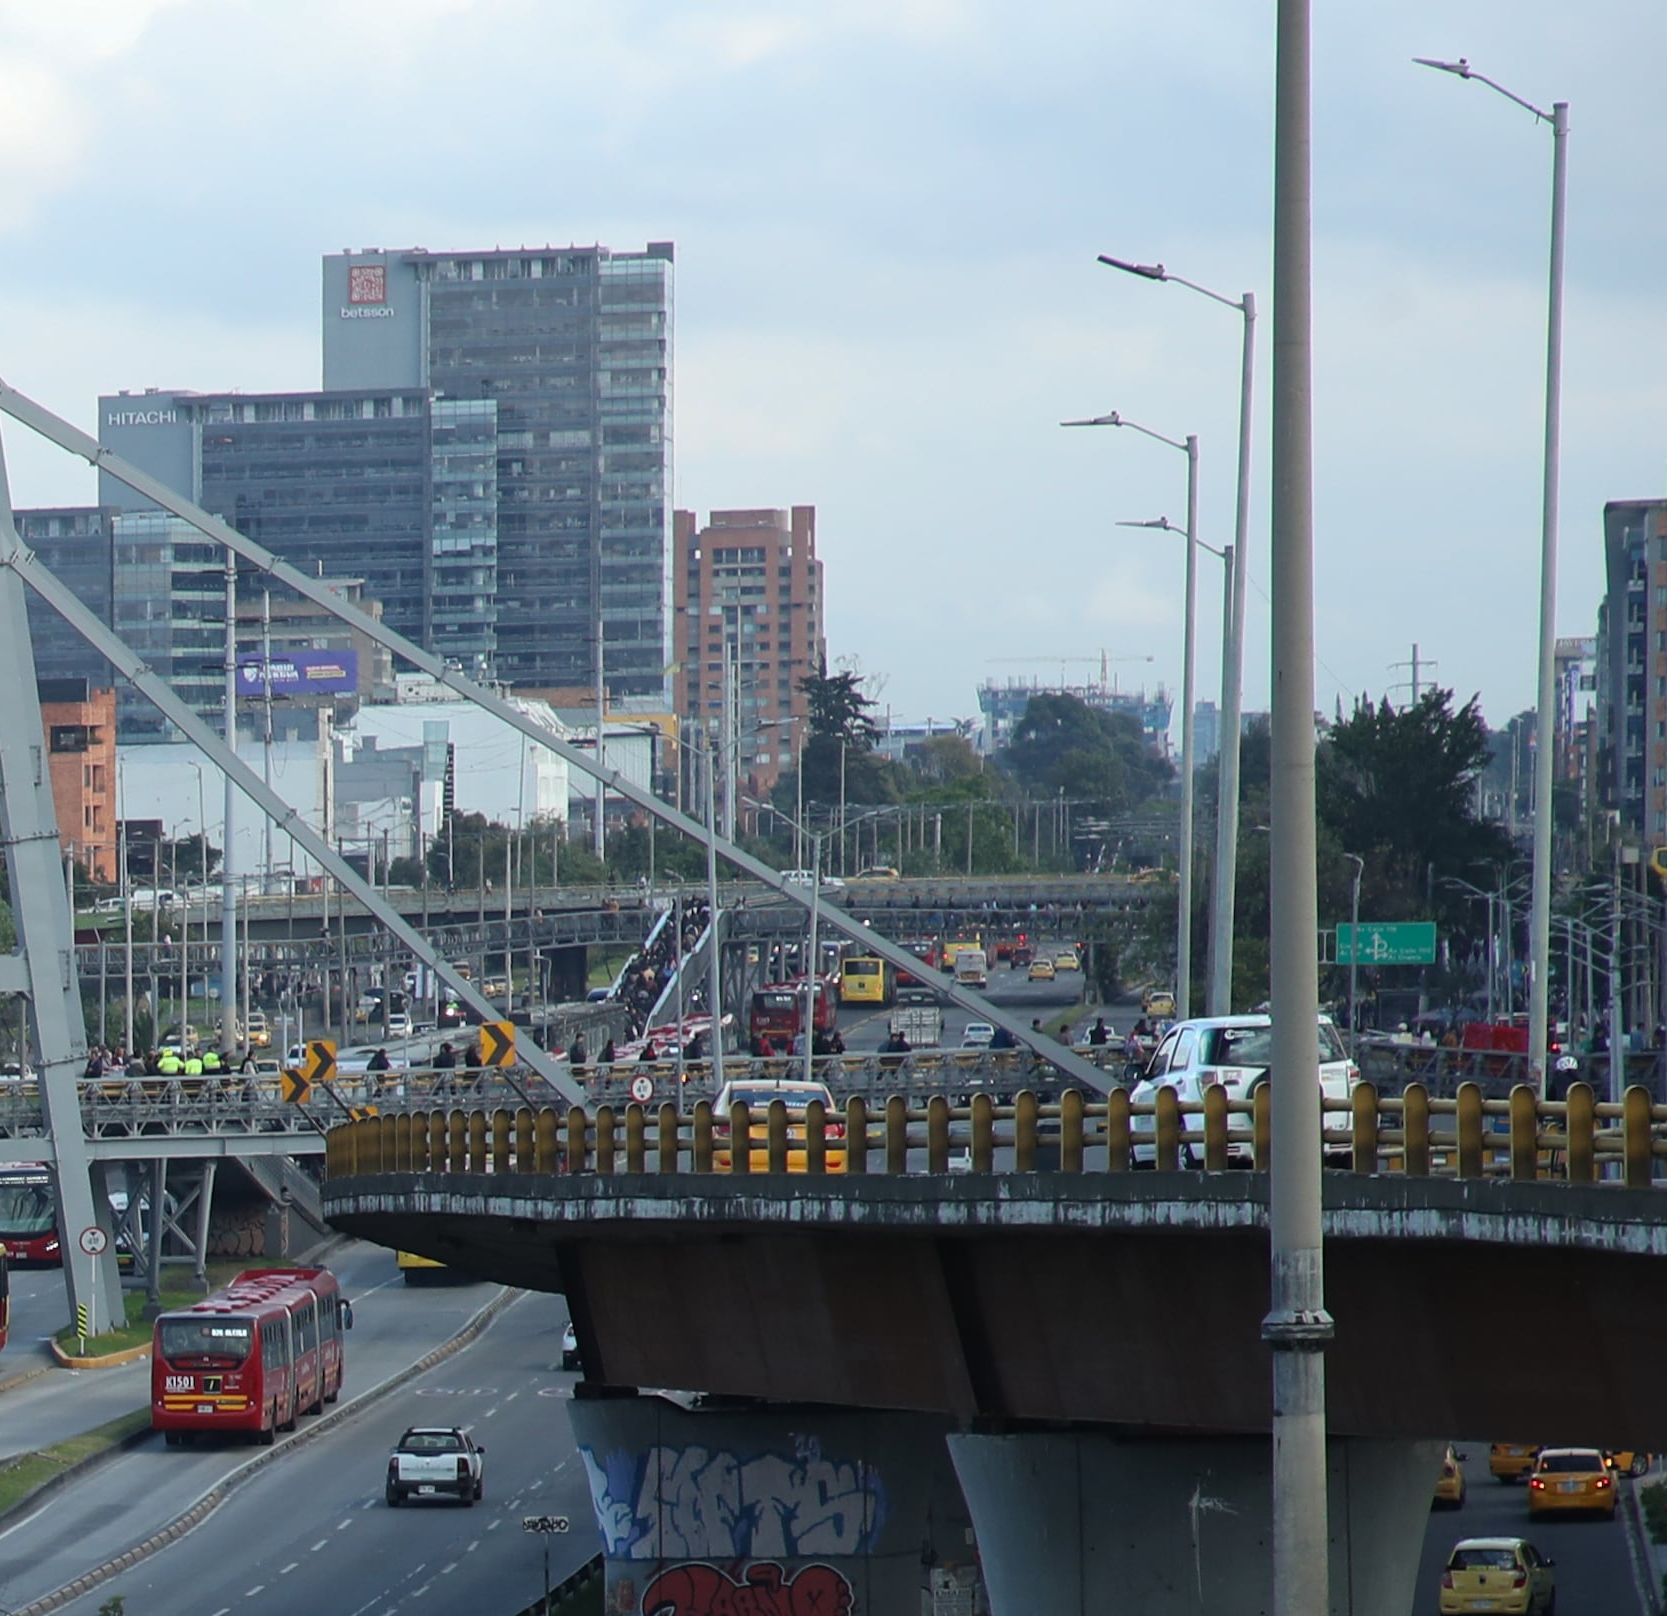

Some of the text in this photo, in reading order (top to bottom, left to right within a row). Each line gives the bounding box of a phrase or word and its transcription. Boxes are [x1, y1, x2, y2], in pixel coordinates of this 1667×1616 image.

[340, 306, 395, 319] betsson
[107, 409, 177, 426] HITACHI
[165, 1375, 195, 1389] K1501
